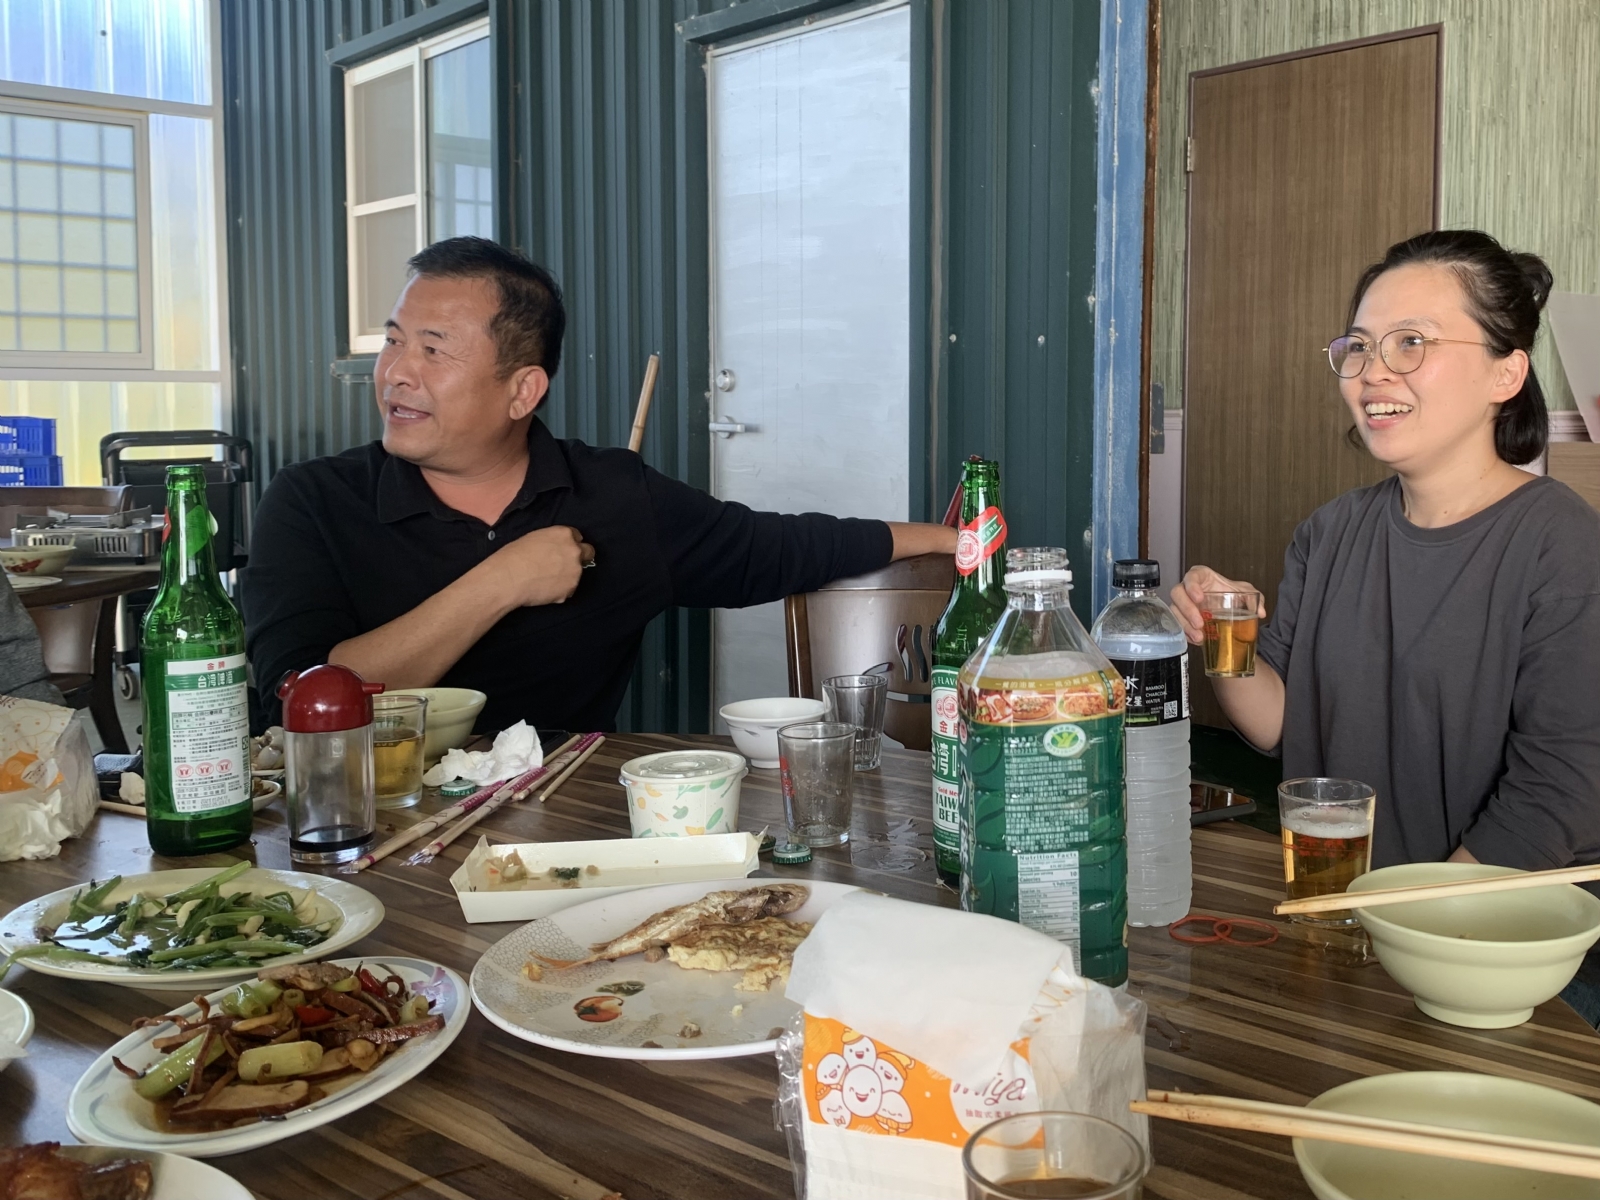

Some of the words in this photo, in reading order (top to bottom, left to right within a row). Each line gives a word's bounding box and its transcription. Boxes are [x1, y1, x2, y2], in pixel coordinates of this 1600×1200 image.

[937, 786, 948, 794] Gold
[935, 792, 959, 811] TAIW
[939, 807, 959, 824] BEE
